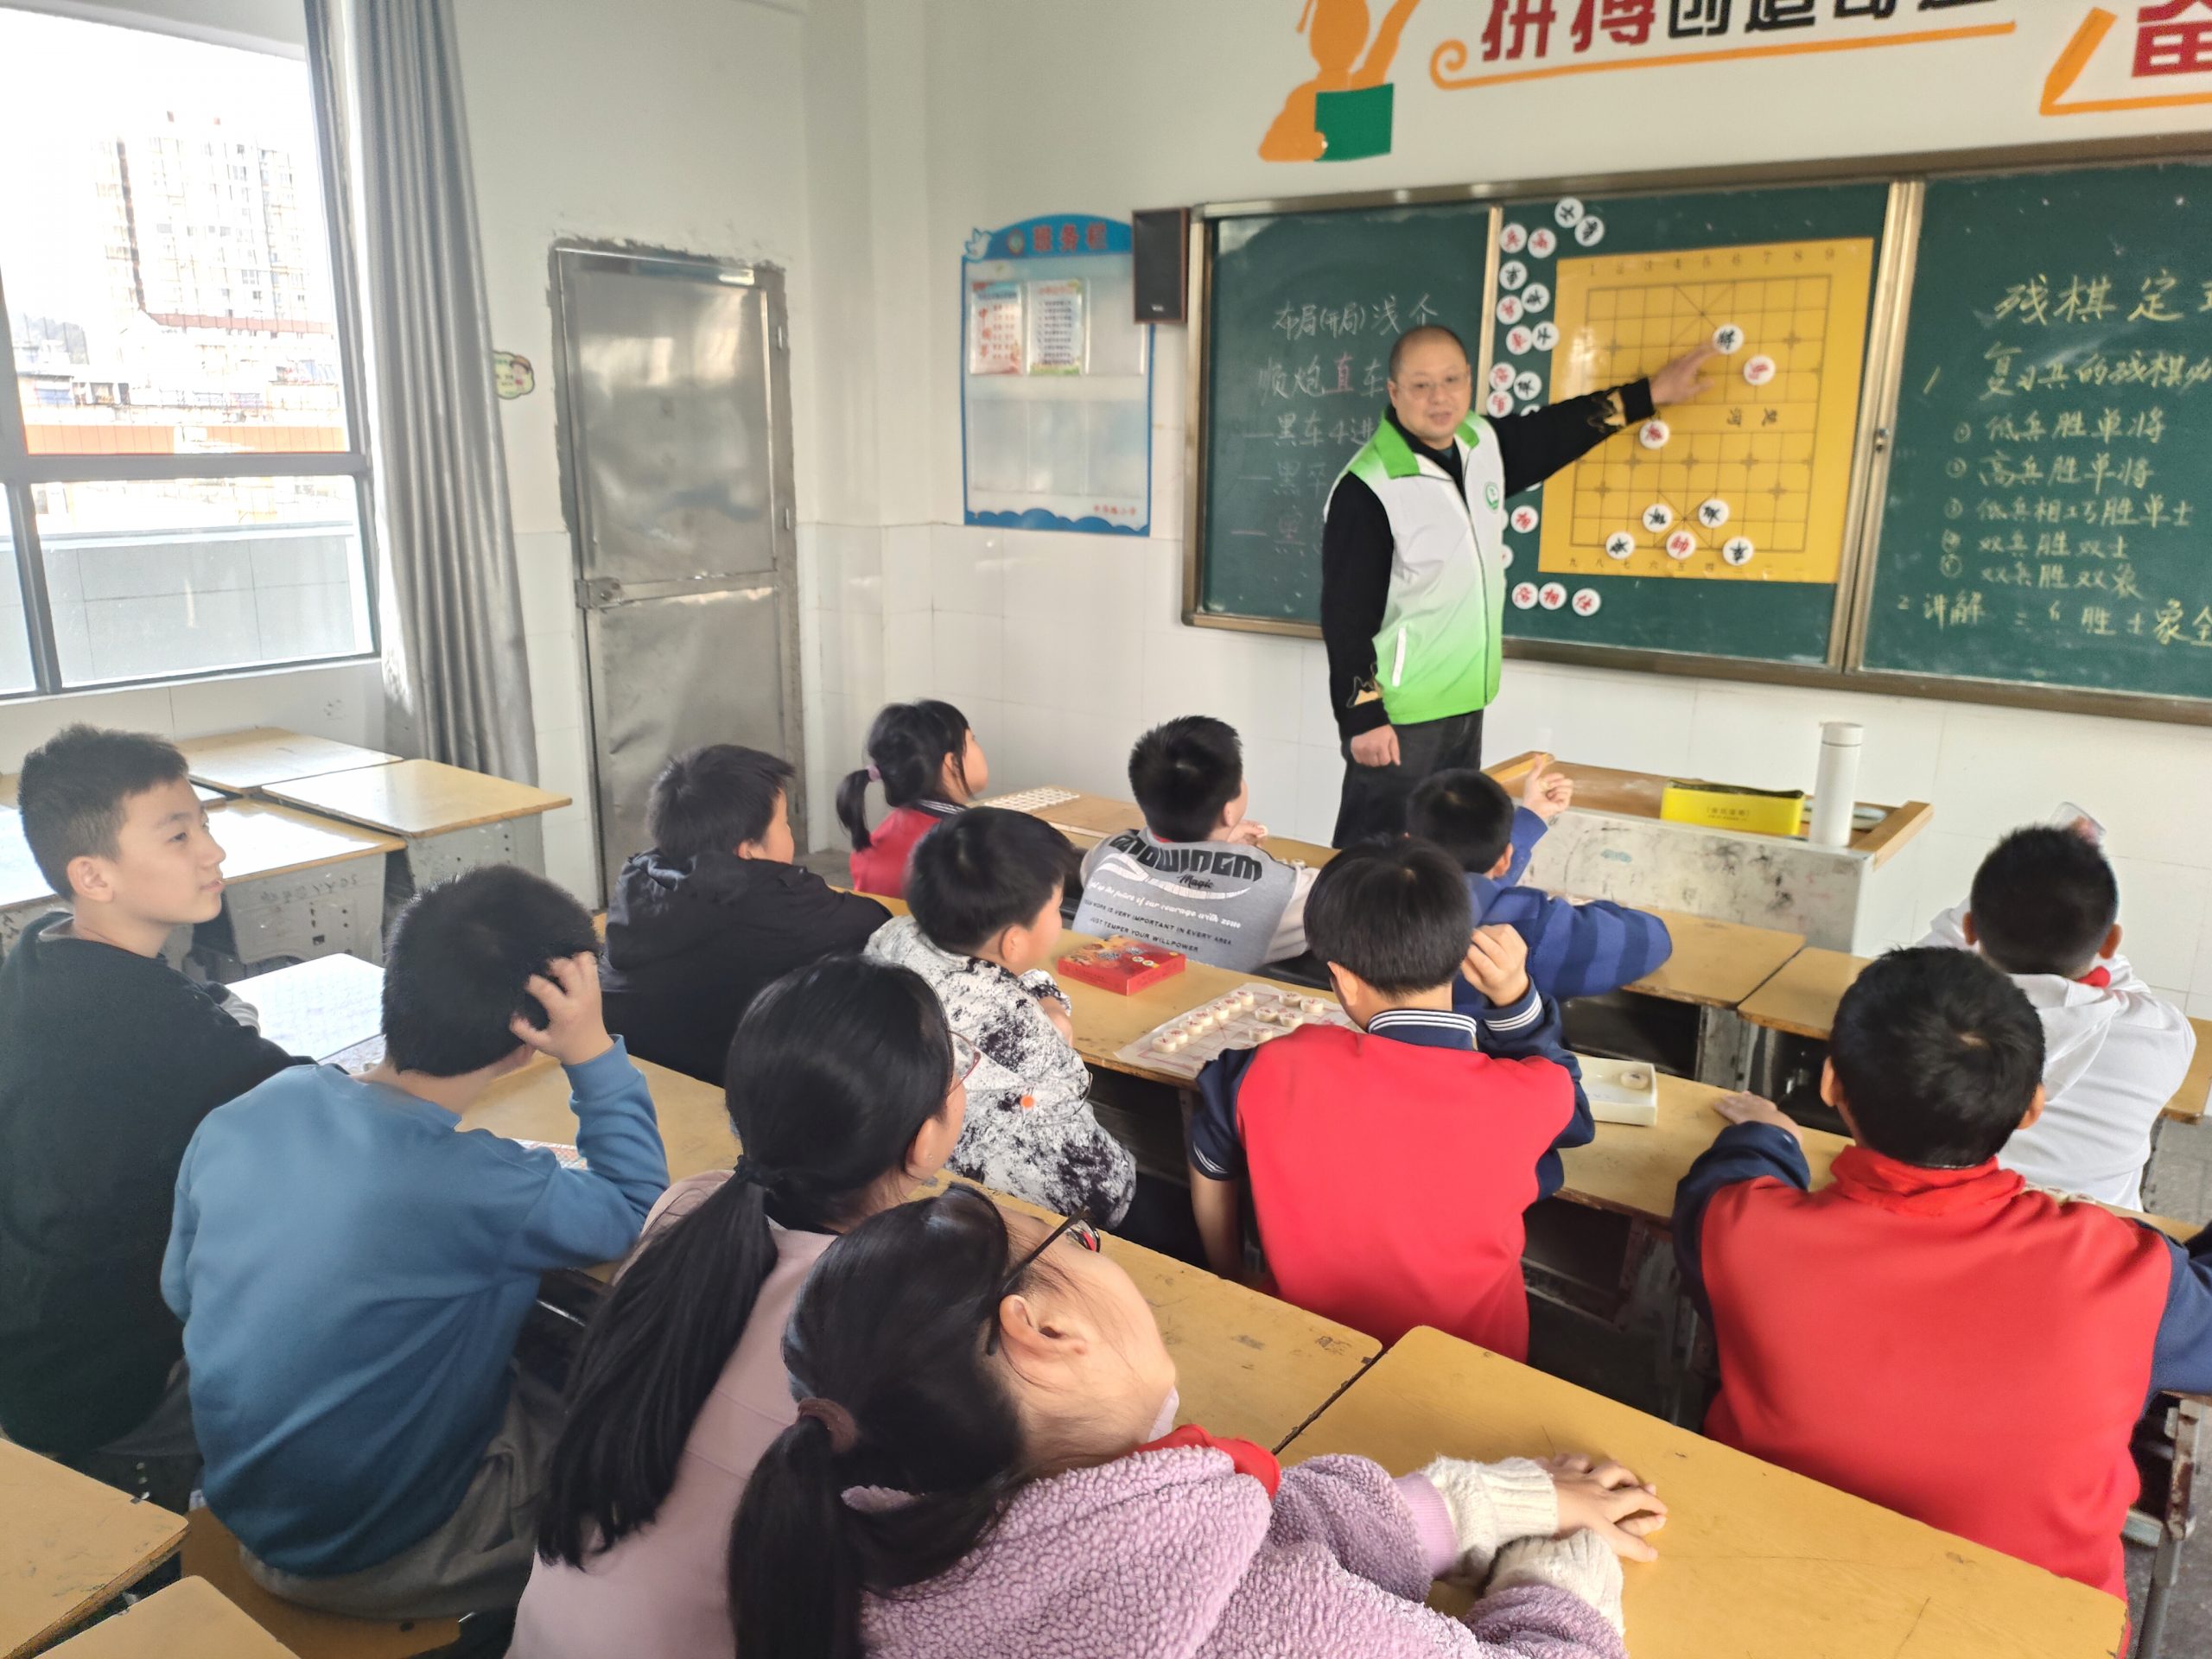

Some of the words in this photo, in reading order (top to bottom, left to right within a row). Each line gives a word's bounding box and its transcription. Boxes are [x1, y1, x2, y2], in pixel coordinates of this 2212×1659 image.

[1993, 268, 2212, 327] 残棋定
[1177, 874, 1215, 889] Magic
[1115, 909, 1131, 918] VERY
[1132, 914, 1175, 931] IMPORTANT
[1187, 929, 1212, 940] EVERY
[1131, 929, 1150, 939] YOUR
[1152, 936, 1199, 952] WILLPOWER
